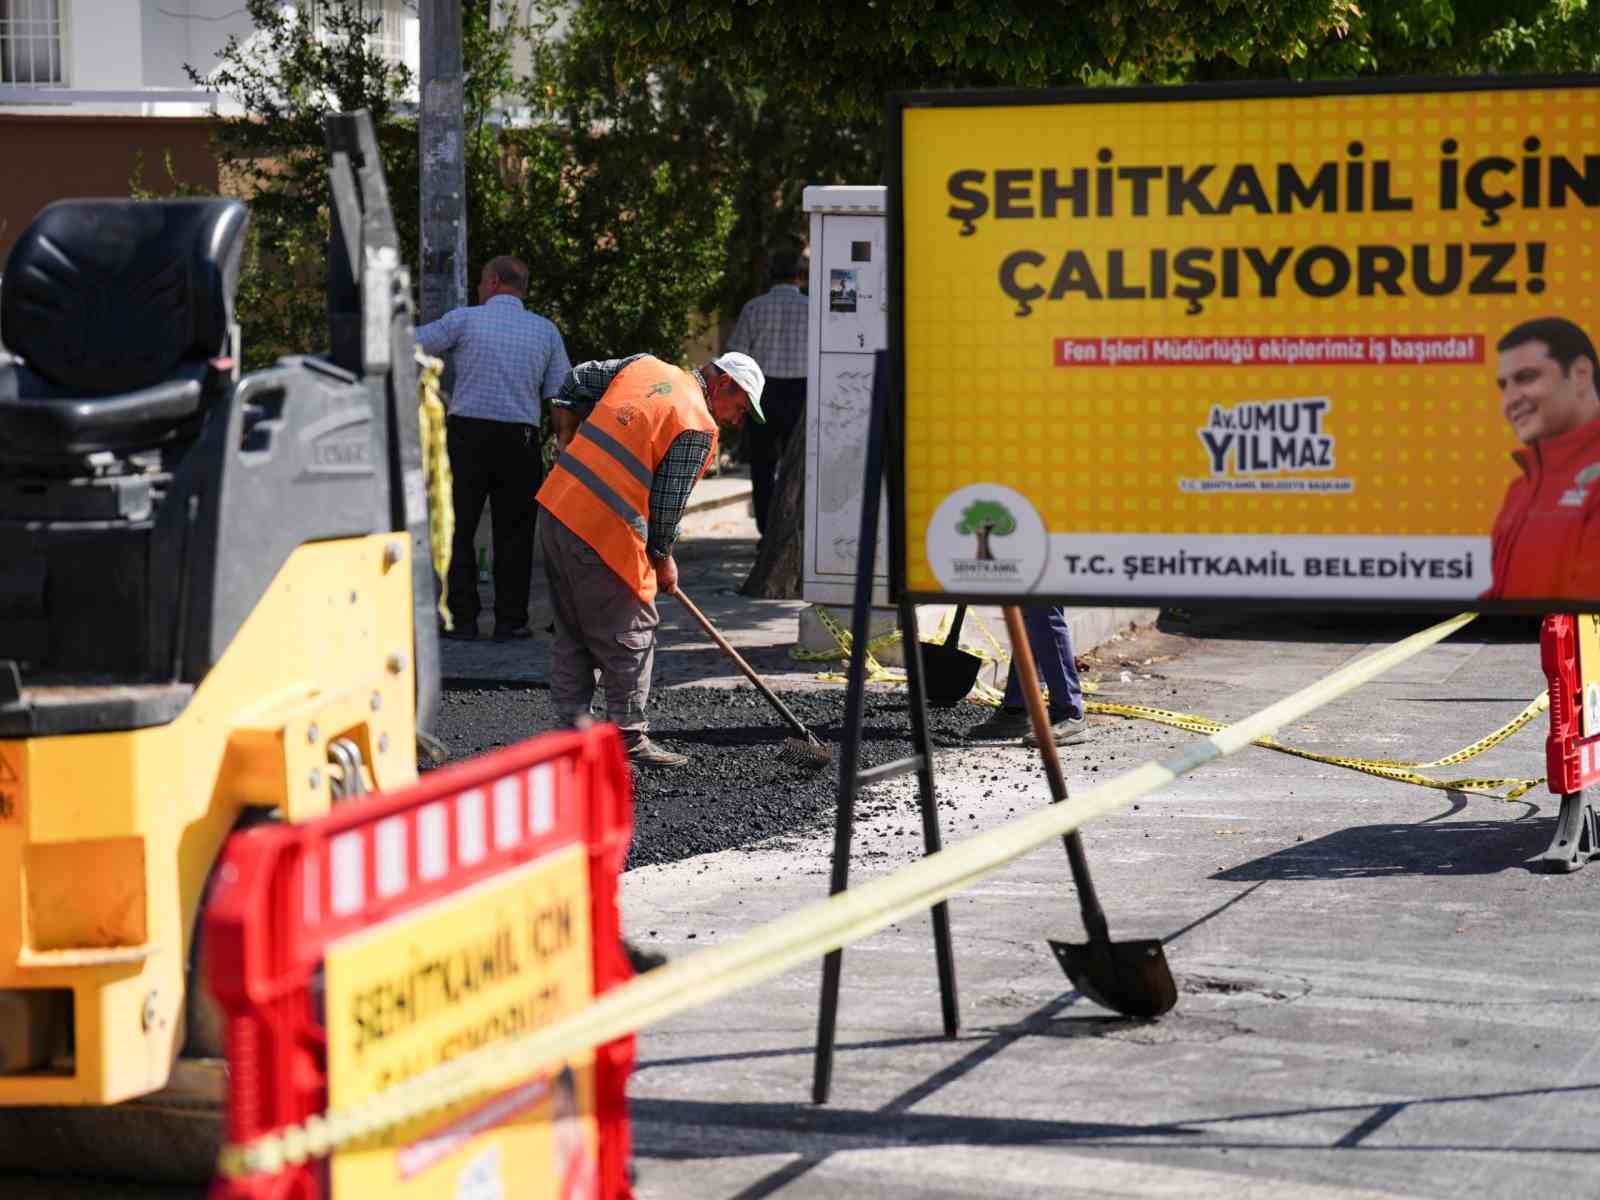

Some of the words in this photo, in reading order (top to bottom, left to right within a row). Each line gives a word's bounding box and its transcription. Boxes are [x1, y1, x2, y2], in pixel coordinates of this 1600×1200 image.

[946, 141, 1412, 236] ŞEHİTKAMİL
[1440, 136, 1600, 227] İÇİN
[998, 242, 1548, 317] ÇALIŞIYORUZ!
[1063, 341, 1096, 360] Fen
[1100, 338, 1148, 364] İşleri
[1153, 338, 1255, 363] Müdürlüğü
[1260, 338, 1363, 361] ekiplerimiz
[1368, 338, 1386, 362] iş
[1390, 337, 1475, 361] başında!
[1201, 432, 1332, 472] YILMAZ
[1064, 555, 1115, 575] T.C.
[1122, 549, 1294, 581] ŞEHİTKAMİL
[1304, 551, 1474, 579] BELEDİYESİ
